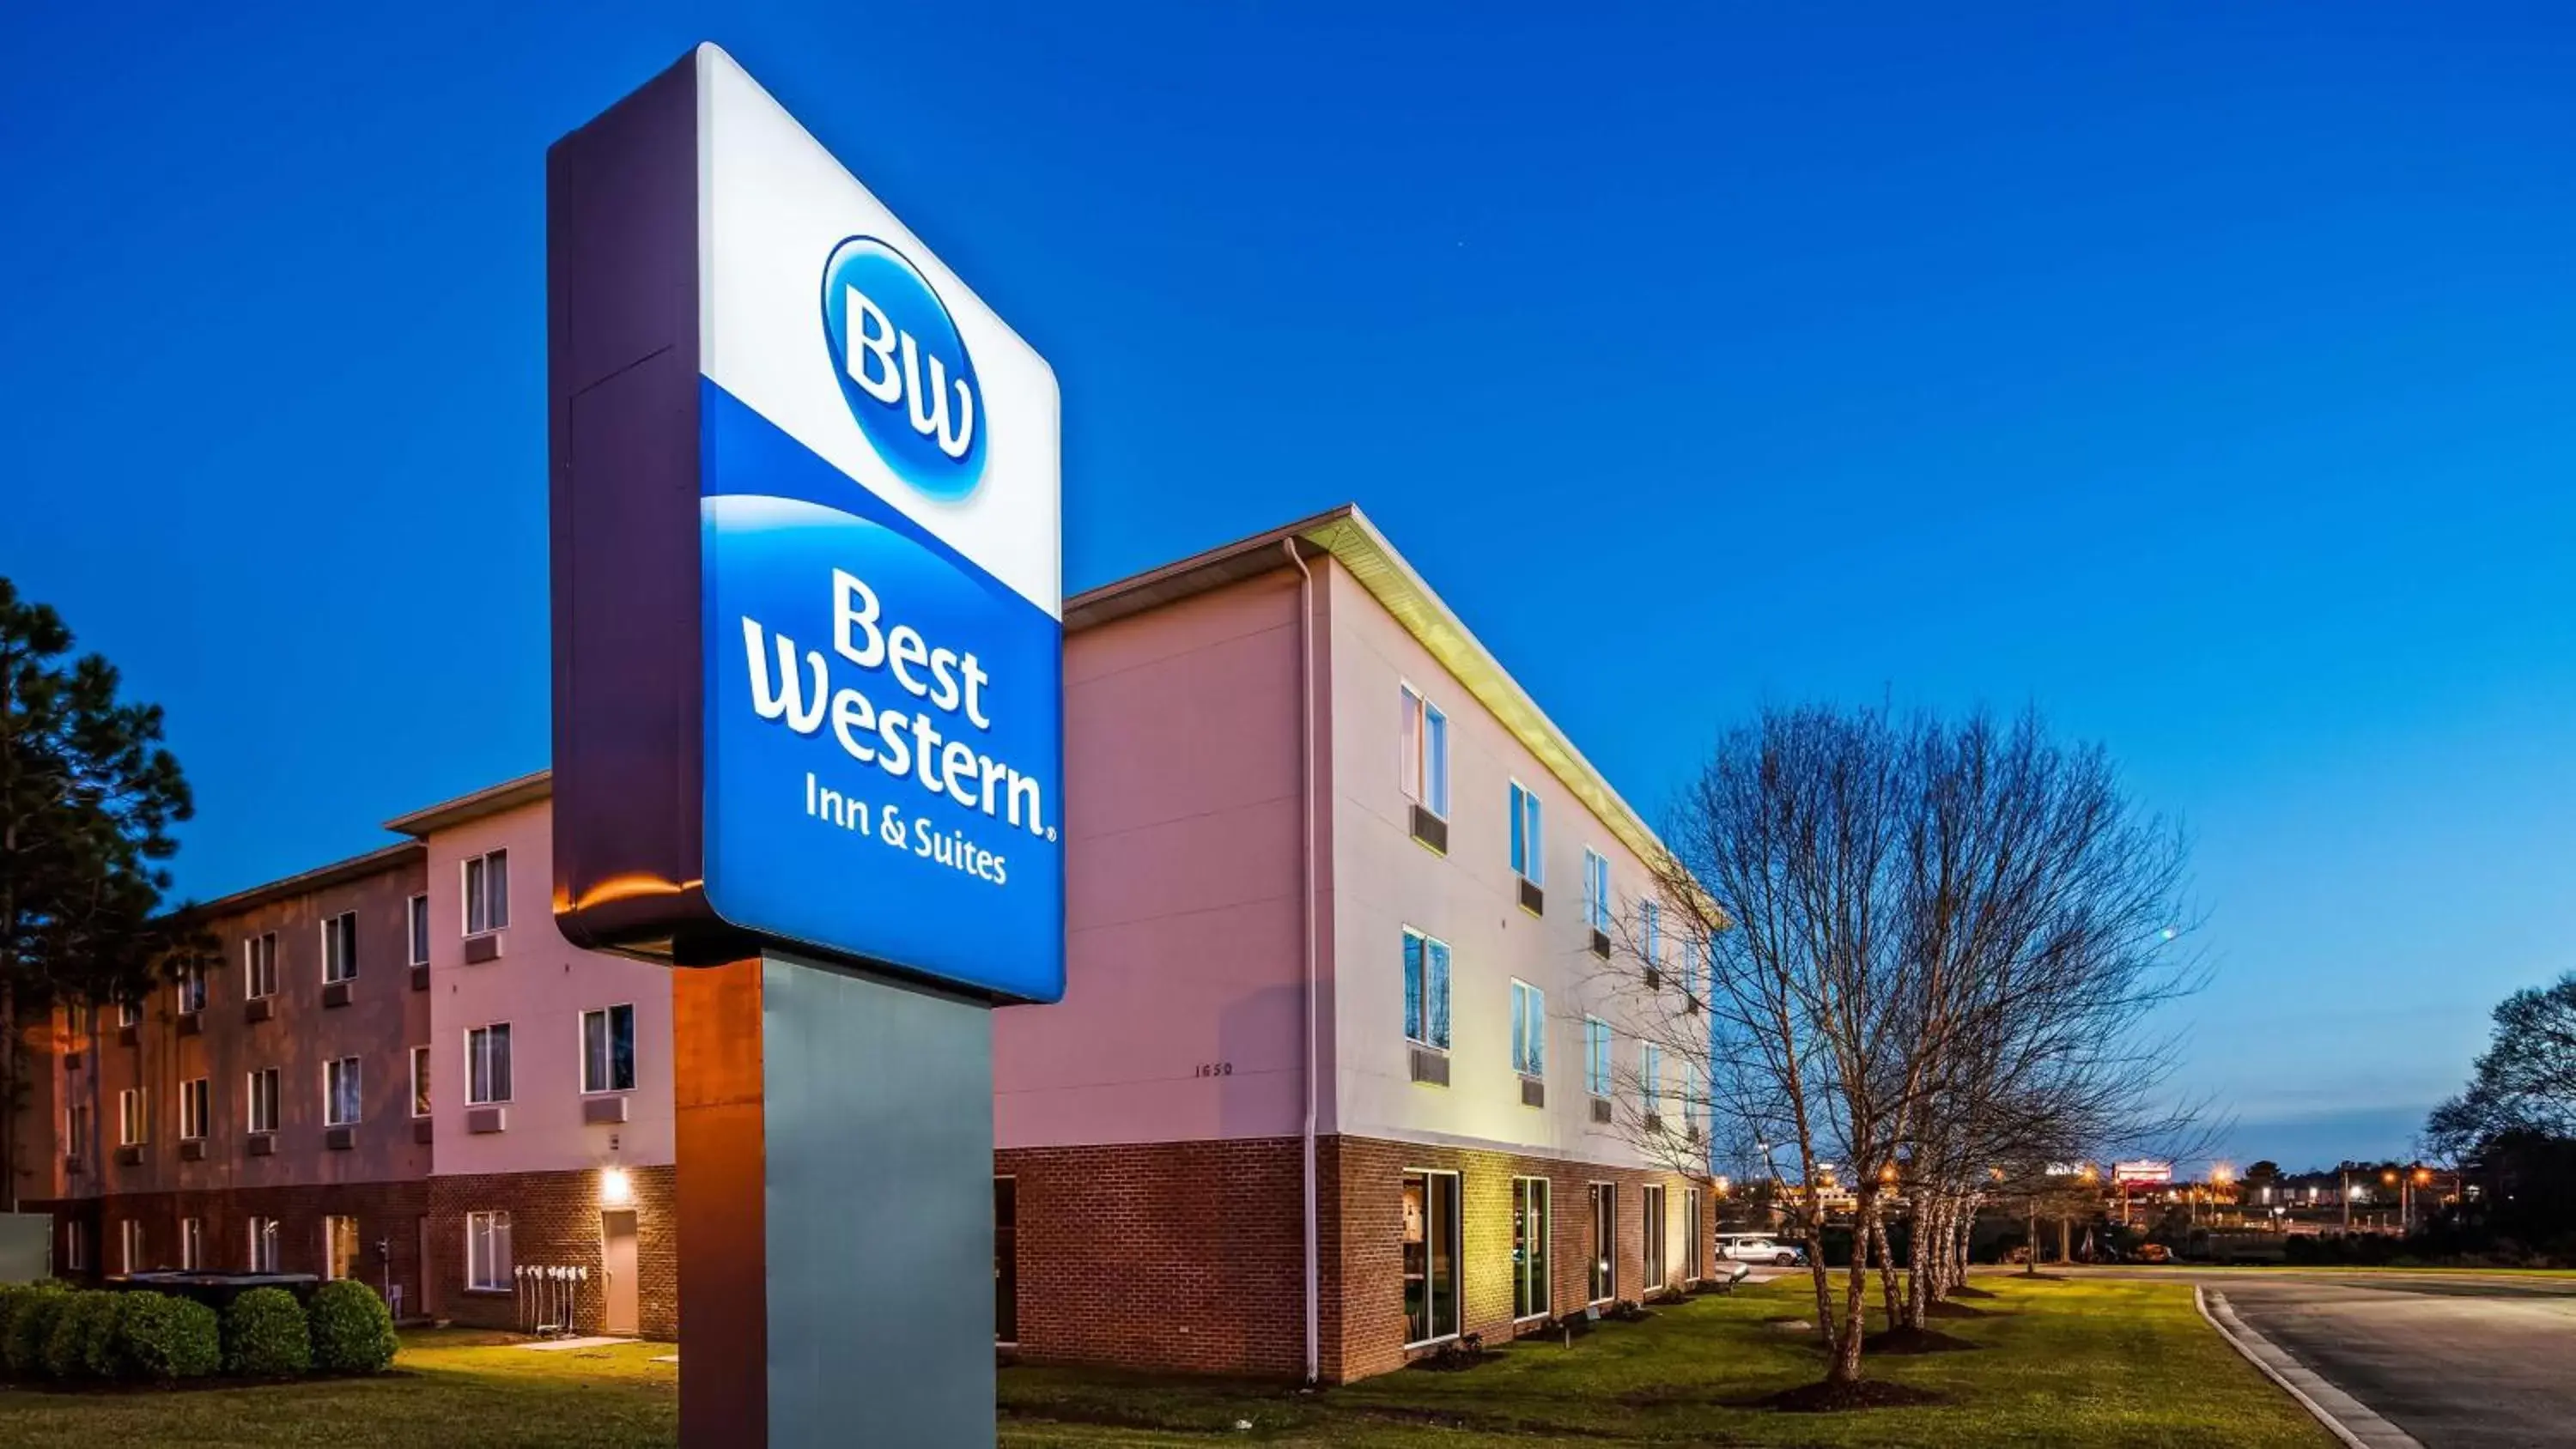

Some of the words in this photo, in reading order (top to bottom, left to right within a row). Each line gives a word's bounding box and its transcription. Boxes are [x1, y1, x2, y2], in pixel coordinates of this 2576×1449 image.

[846, 283, 973, 458] BW
[832, 567, 990, 730] Best
[805, 771, 871, 837] Inn
[880, 803, 908, 850] &
[914, 816, 1007, 886] Suites
[1195, 1062, 1232, 1078] 1650
